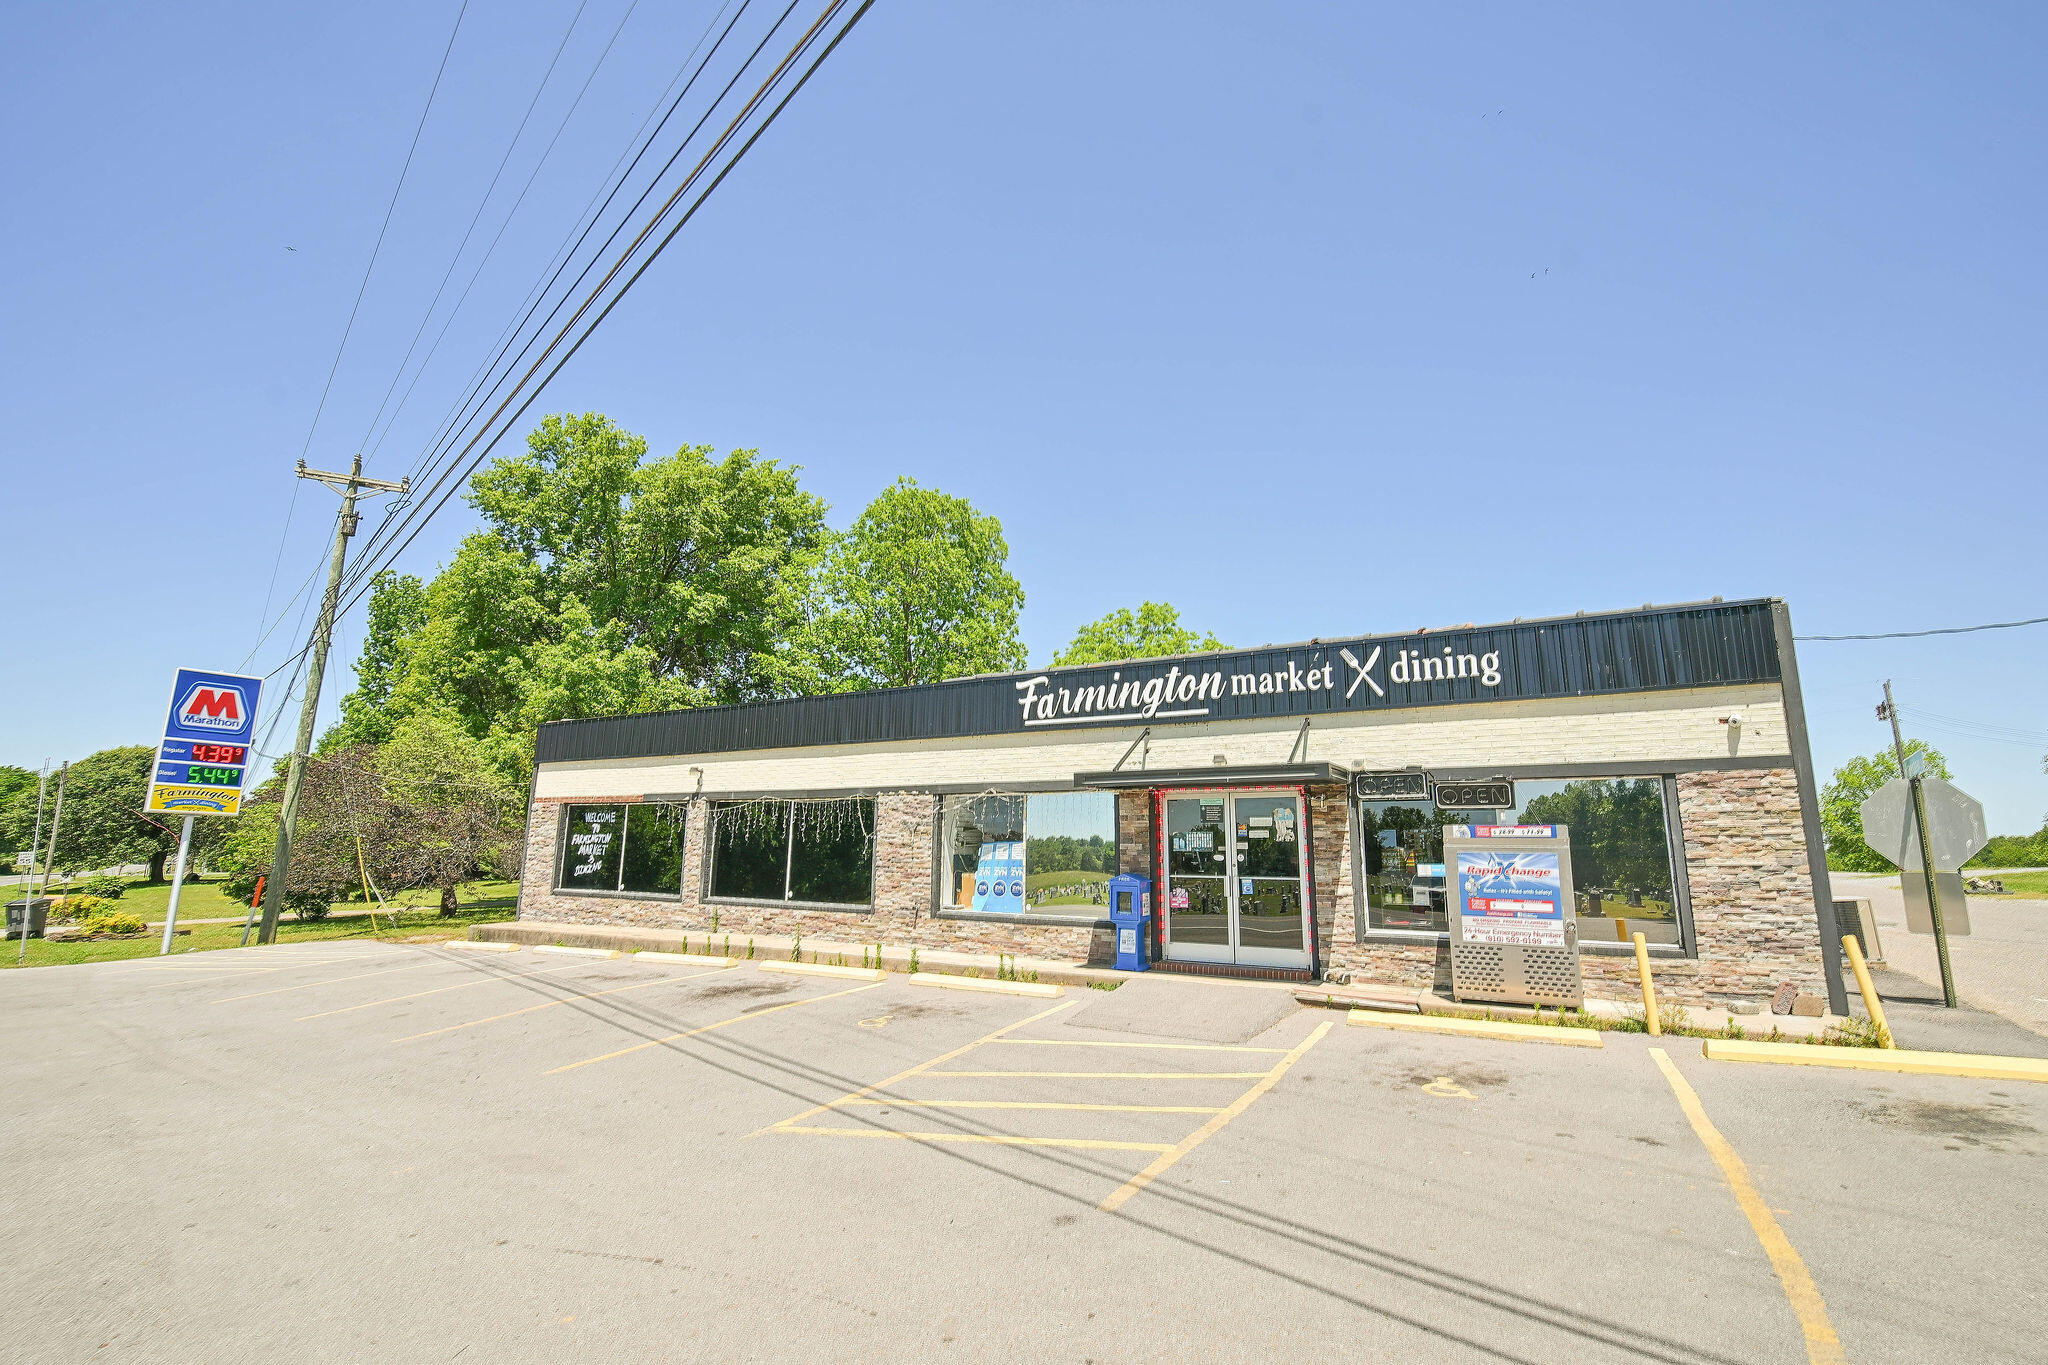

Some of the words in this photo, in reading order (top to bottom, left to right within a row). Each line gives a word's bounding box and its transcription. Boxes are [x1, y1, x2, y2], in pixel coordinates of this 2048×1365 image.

[1015, 666, 1227, 719] Farmington
[1231, 660, 1334, 696] market
[1390, 646, 1501, 687] dining
[183, 714, 240, 727] Marathon
[162, 746, 187, 755] Regular
[157, 769, 177, 777] Diesel
[1361, 776, 1423, 794] OPEN
[153, 786, 237, 802] Farmington
[1441, 788, 1506, 804] OPEN
[584, 811, 616, 823] WELCOME
[578, 844, 609, 856] MARKET
[993, 866, 1008, 877] ZYN
[1464, 926, 1491, 934] 24-Hour
[1492, 928, 1532, 938] Emergency
[1533, 930, 1563, 938] Number
